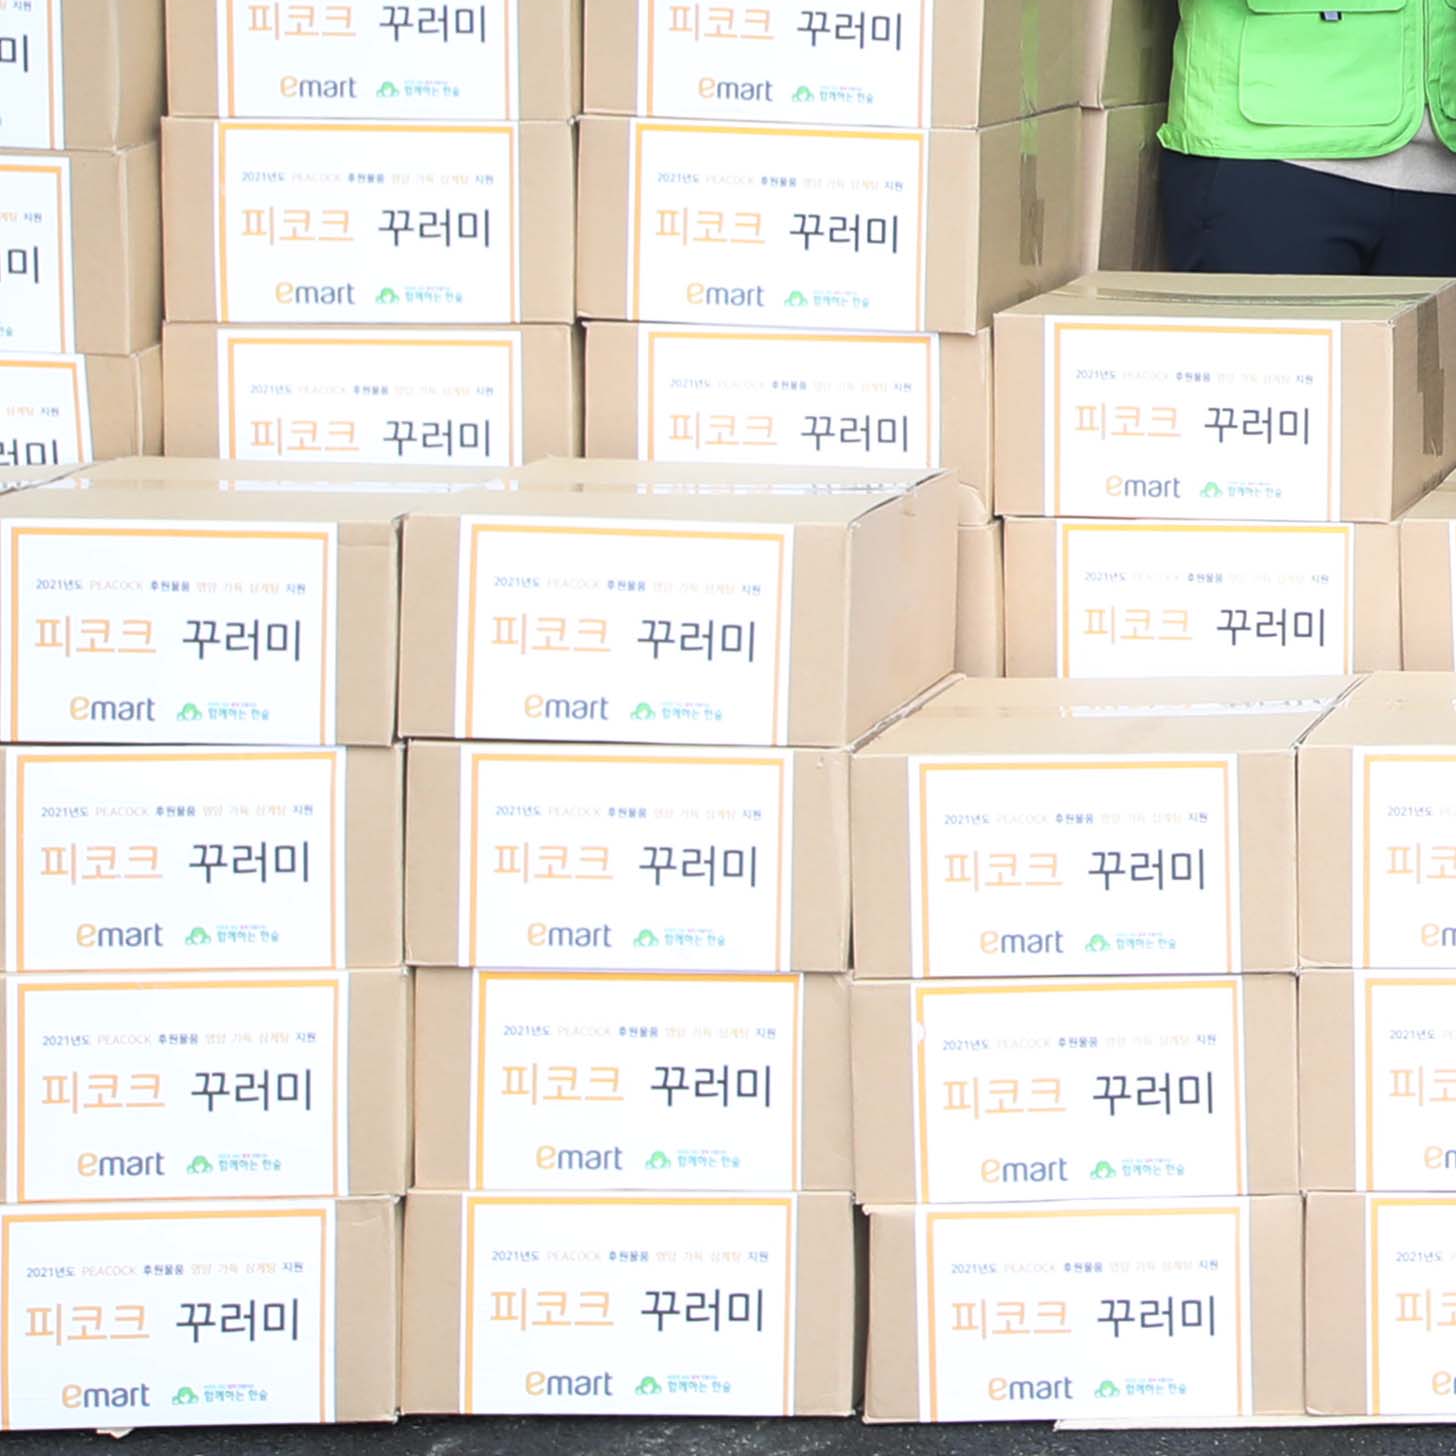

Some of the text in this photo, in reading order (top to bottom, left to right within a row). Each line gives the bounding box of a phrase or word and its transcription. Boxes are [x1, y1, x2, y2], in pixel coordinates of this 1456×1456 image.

[248, 2, 486, 43] 피코크 꾸러미
[279, 73, 358, 98] emart
[242, 207, 490, 248] 피코크 꾸러미
[274, 279, 356, 304] emart
[1076, 403, 1309, 445] 피코크 꾸러미
[1105, 472, 1181, 498] emart
[35, 579, 82, 591] 2021년도
[35, 616, 301, 662] 피코크 꾸러미
[492, 613, 755, 663] 피코크 꾸러미
[69, 693, 156, 722] emart
[523, 691, 609, 720] emart
[944, 848, 1204, 891] 피코크 꾸러미
[979, 927, 1065, 954] emart
[42, 1068, 311, 1114] 피코크 꾸러미
[502, 1063, 771, 1108] 피코크 꾸러미
[77, 1149, 166, 1177] emart
[535, 1142, 624, 1171] emart
[491, 1288, 763, 1332] 피코크 꾸러미
[524, 1369, 614, 1396] emart
